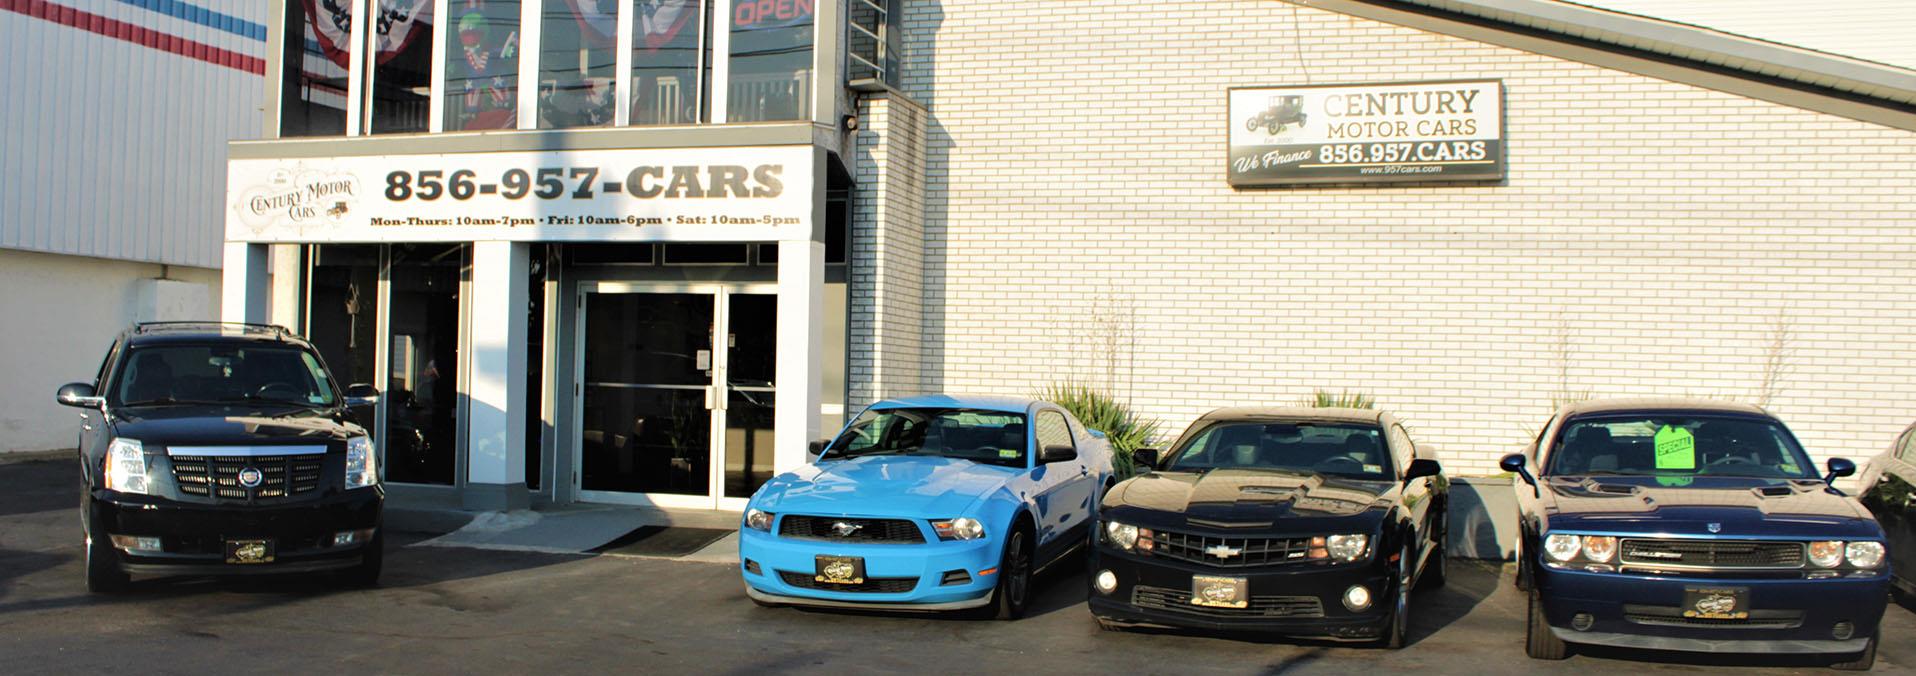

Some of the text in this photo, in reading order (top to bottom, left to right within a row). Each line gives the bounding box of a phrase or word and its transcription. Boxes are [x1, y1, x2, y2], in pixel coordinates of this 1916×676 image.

[735, 0, 813, 25] OPEN
[1324, 90, 1479, 117] CENTURY
[1327, 118, 1477, 139] MOTOR CARS
[1234, 149, 1312, 173] We Finance
[1319, 141, 1487, 164] 856.957.CARS
[1360, 165, 1443, 175] www.957cars.com
[384, 164, 784, 201] 856-957-CARS
[370, 213, 801, 228] Mon-Thurs: 10am-7pm Fri: 10am-6pm Sat: 10am-5pm
